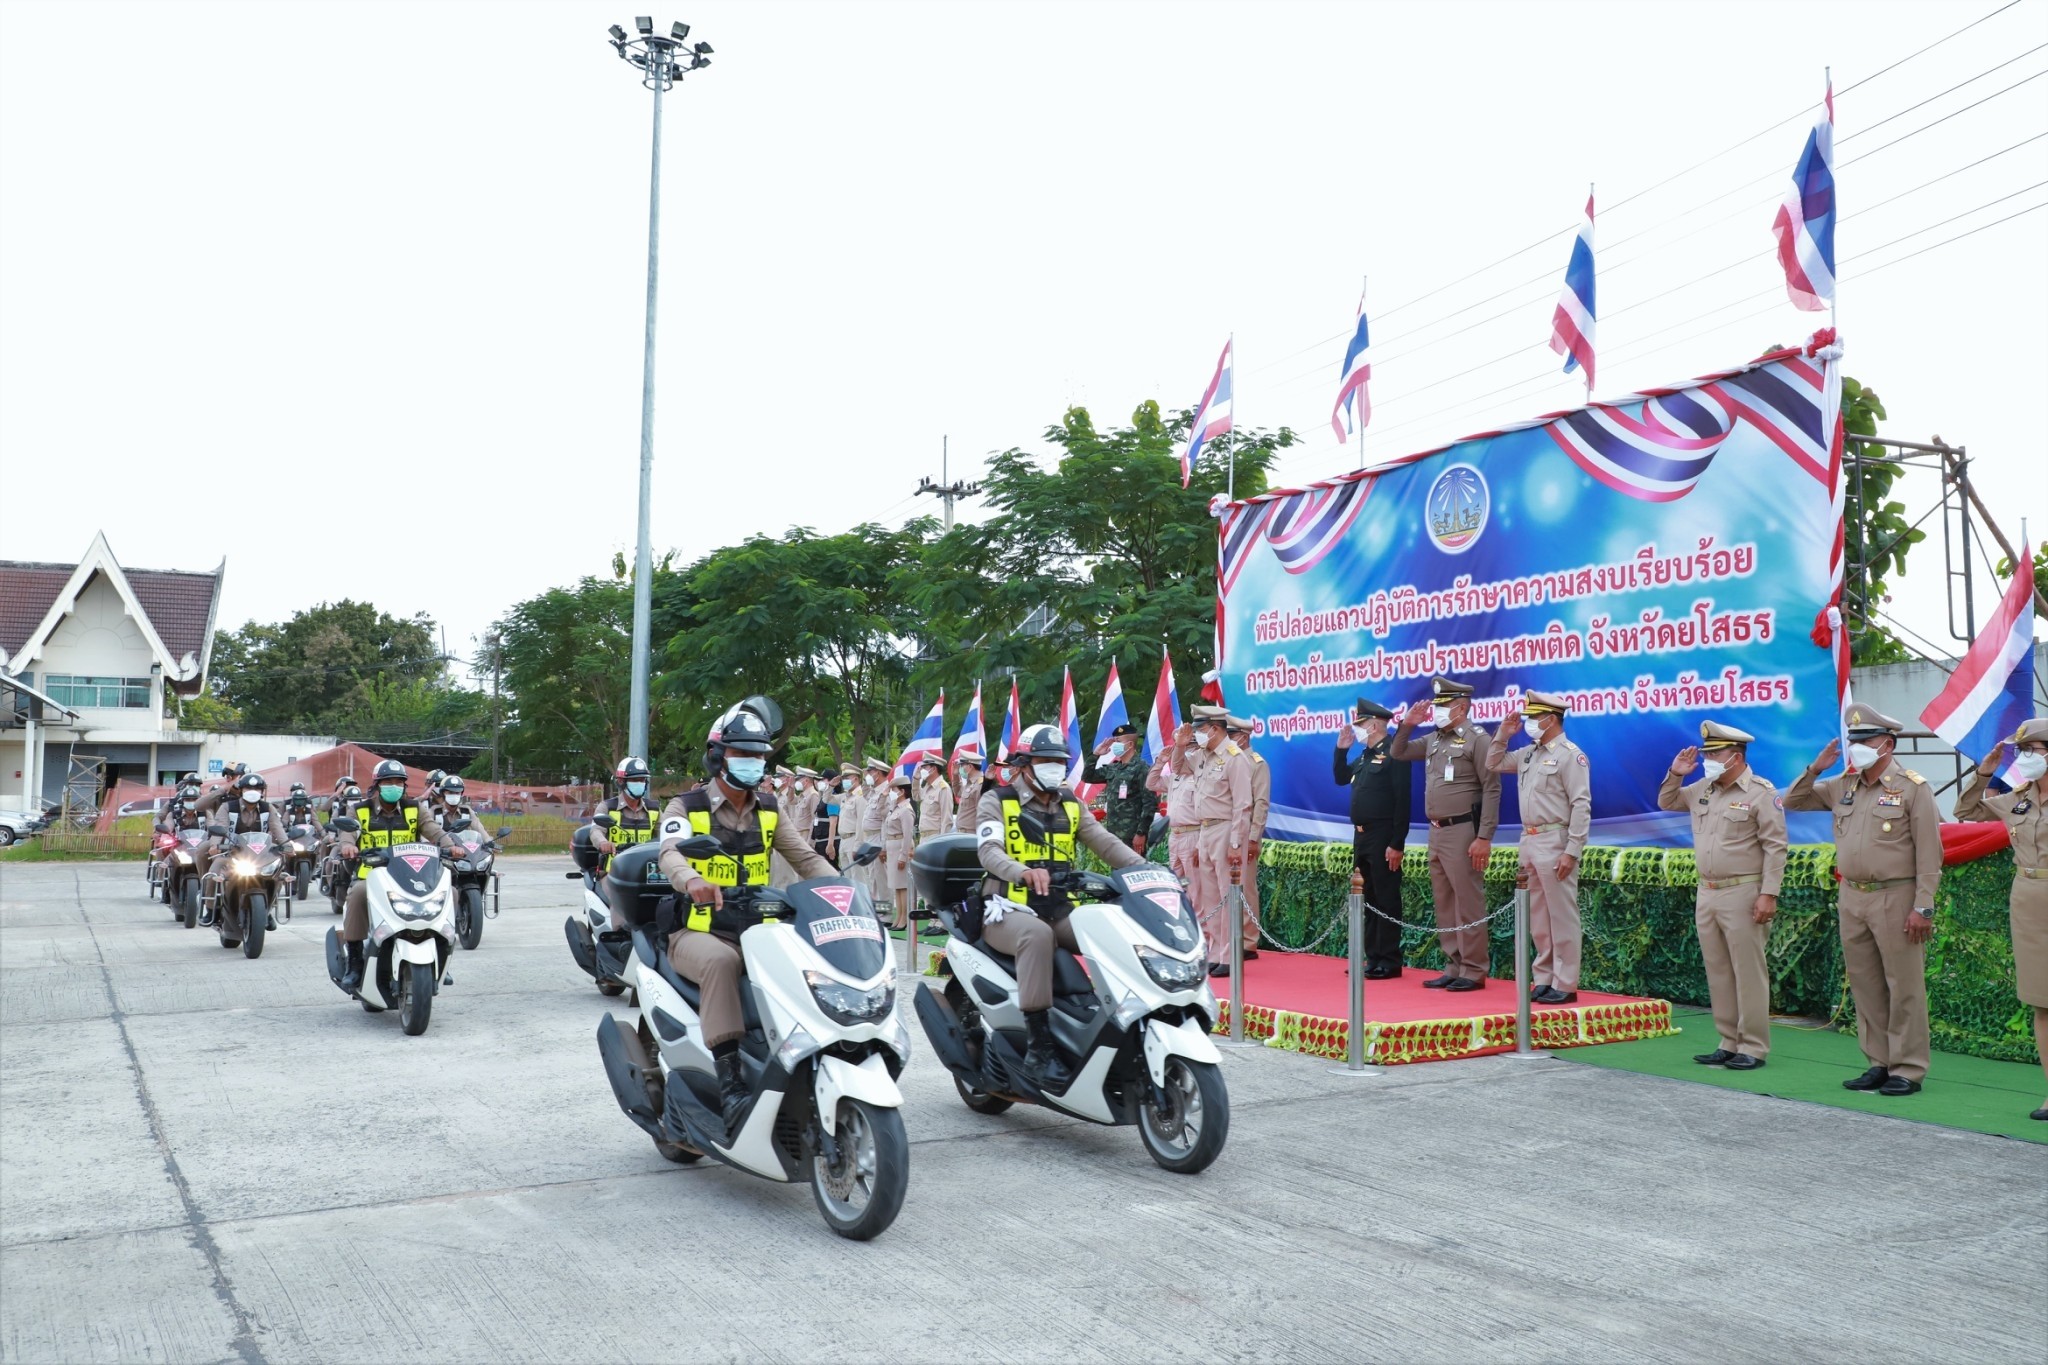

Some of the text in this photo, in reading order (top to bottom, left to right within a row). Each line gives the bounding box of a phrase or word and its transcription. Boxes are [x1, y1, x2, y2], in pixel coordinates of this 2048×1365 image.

[1256, 537, 1753, 641] พิธีปล่อยแถวปฏิบัติการรักษาความสงบเรียบร้อย
[1247, 602, 1771, 691] การป้องกันและปราบปรามยาเสพติด จังหวัดยโสธร
[1269, 707, 1343, 738] พฤศจิกายน
[1634, 670, 1788, 709] จังหวัดยโสธร
[813, 918, 852, 935] TRAFFIC
